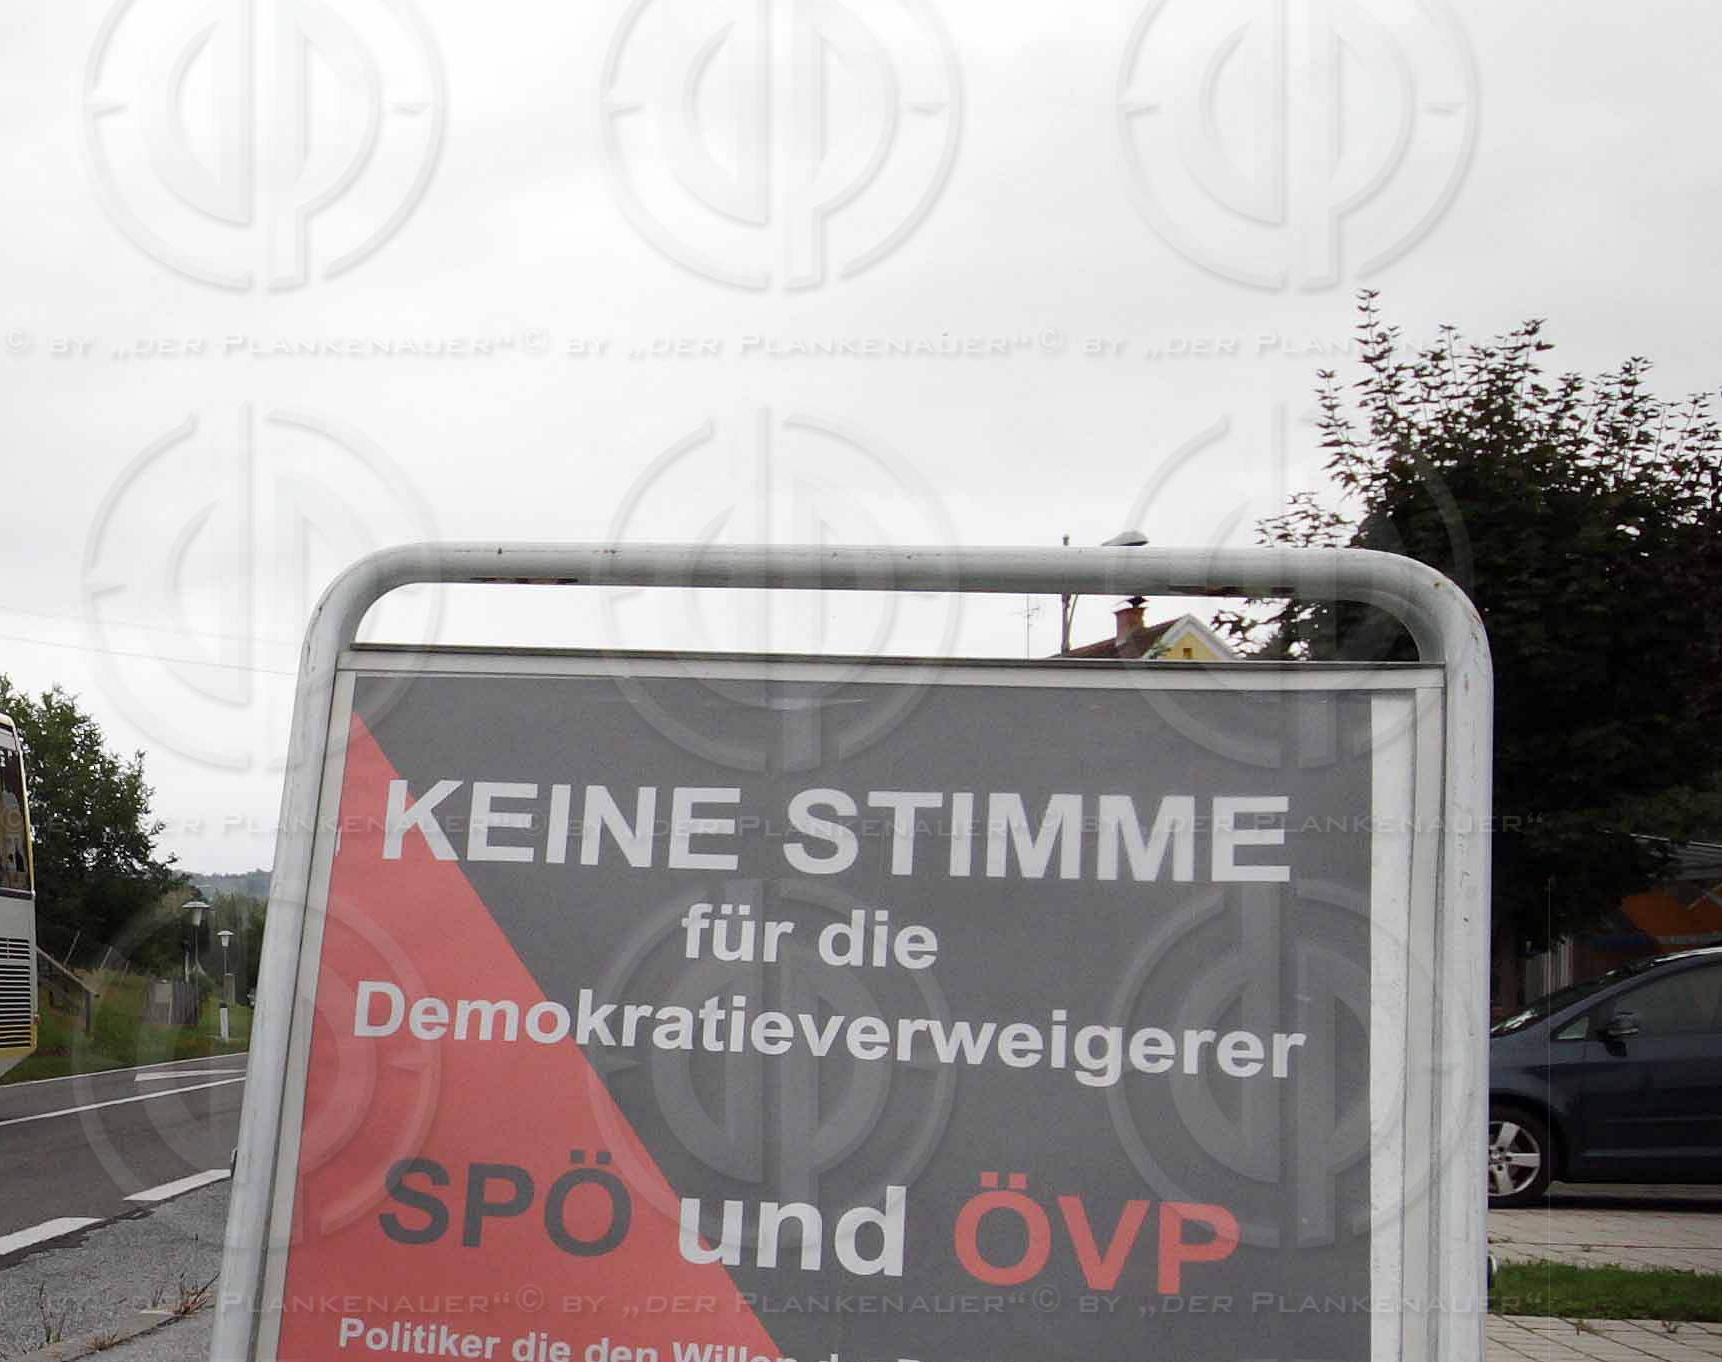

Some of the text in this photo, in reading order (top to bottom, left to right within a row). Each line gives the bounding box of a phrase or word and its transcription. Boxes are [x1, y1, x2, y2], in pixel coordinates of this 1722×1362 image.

[383, 780, 1290, 881] KEINE STIMME
[682, 903, 937, 969] für die
[355, 982, 1306, 1086] Demokratieverweigerer
[380, 1149, 1237, 1293] SPÖ und ÖVP
[339, 1317, 500, 1358] Politiker
